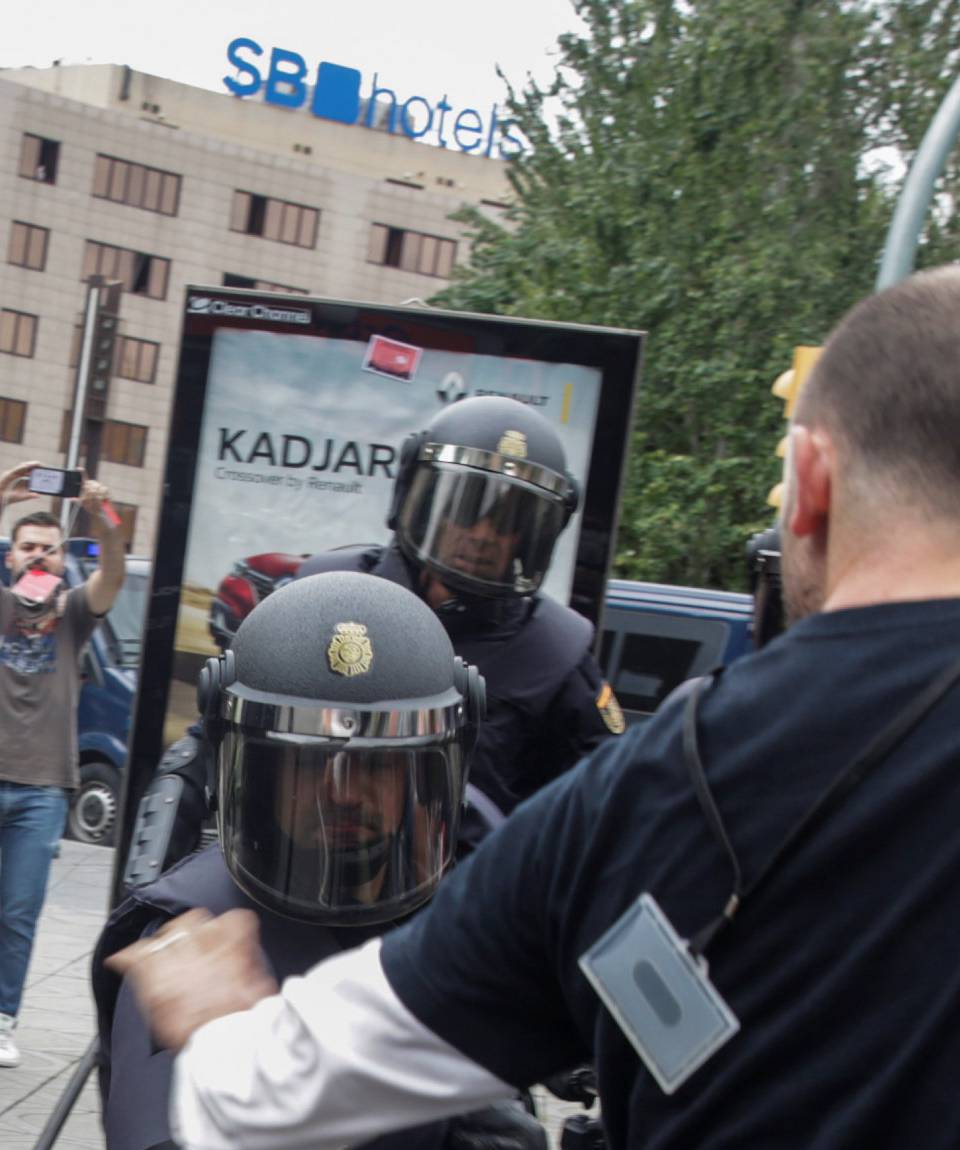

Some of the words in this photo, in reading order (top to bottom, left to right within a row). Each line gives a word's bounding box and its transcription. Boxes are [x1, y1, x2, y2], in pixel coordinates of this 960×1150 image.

[223, 37, 307, 109] SB
[365, 72, 531, 160] hotels
[217, 427, 397, 480] KADJAR
[214, 466, 283, 487] Crossover
[285, 474, 304, 491] by
[306, 476, 363, 495] Renault
